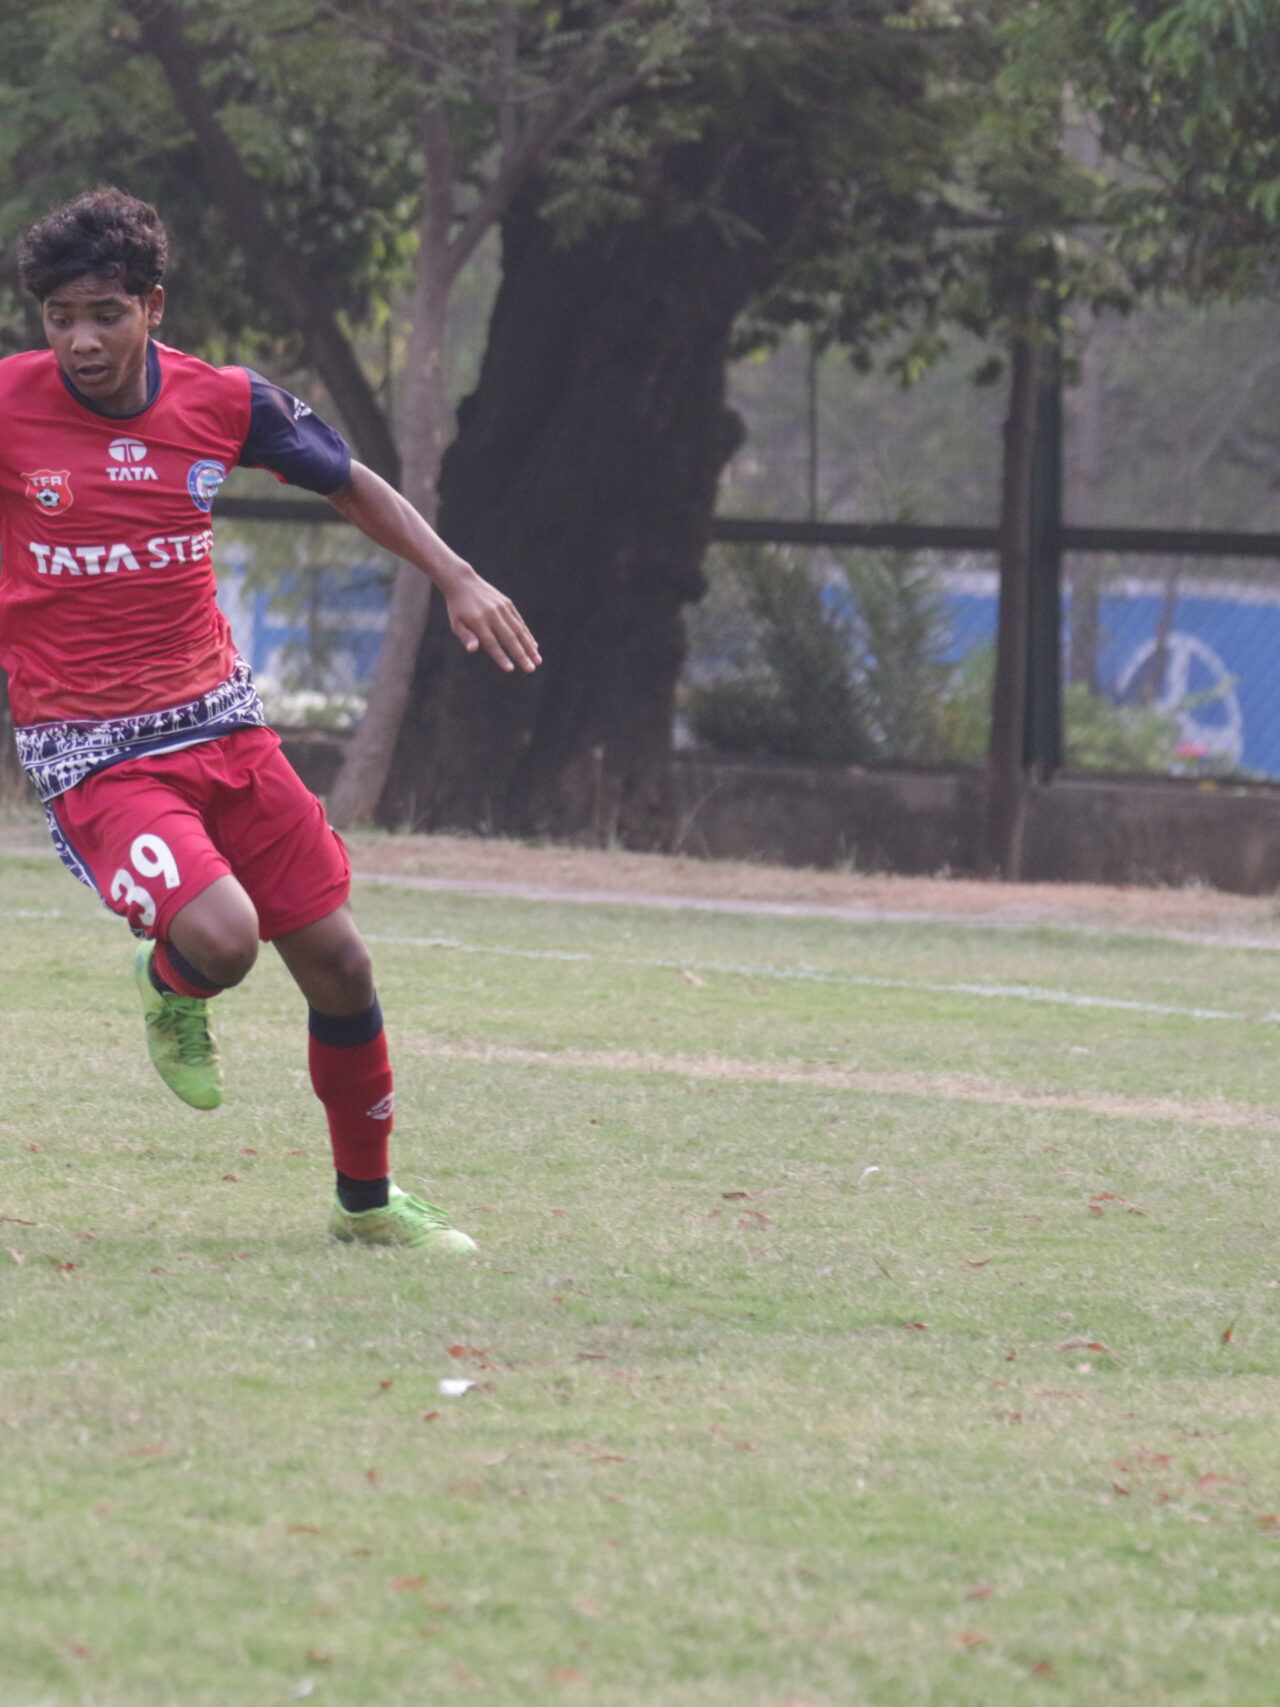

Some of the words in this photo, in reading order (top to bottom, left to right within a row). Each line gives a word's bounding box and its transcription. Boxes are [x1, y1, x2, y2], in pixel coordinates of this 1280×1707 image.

[106, 467, 159, 481] TATA
[29, 541, 141, 576] TATA
[111, 833, 181, 927] 39
